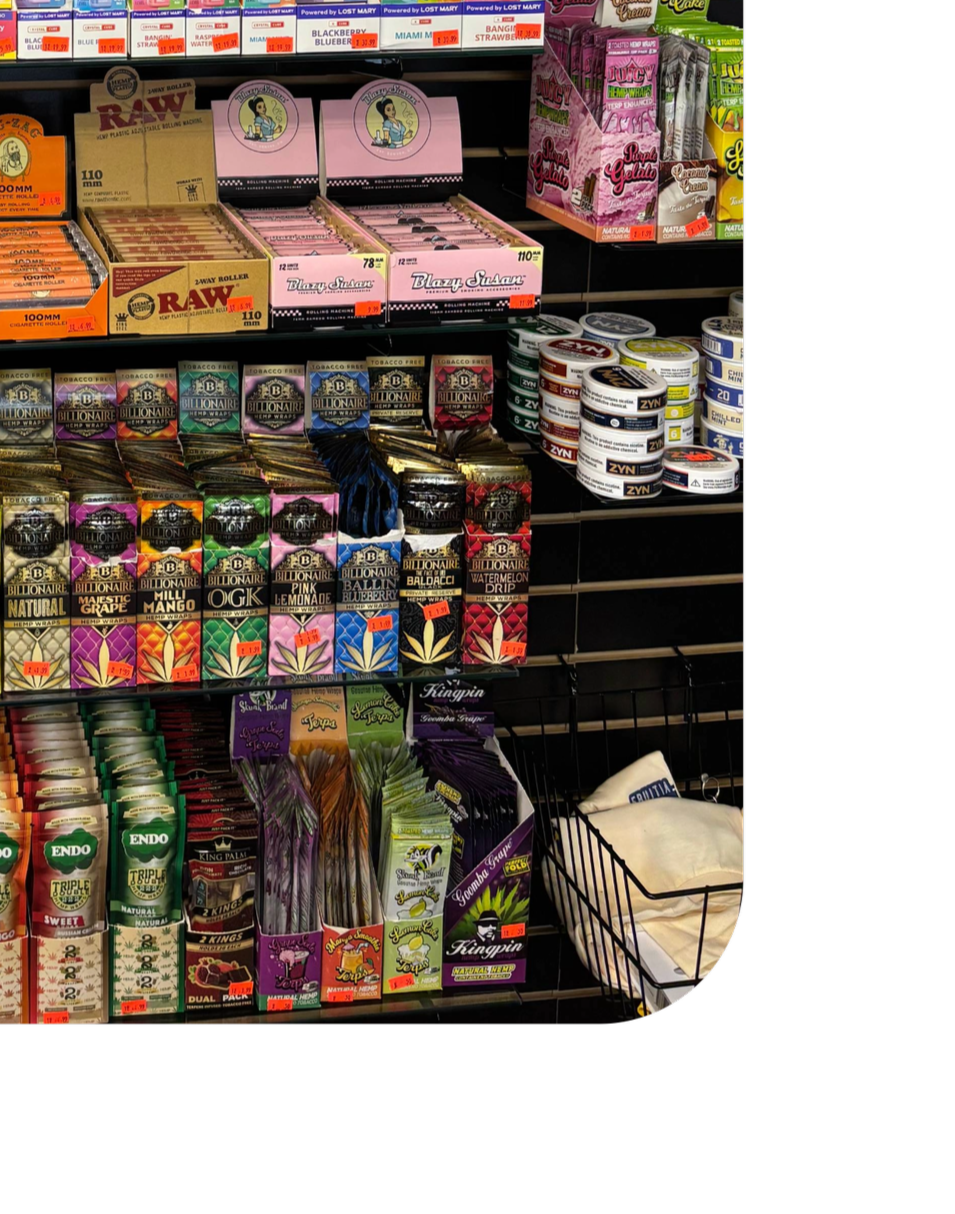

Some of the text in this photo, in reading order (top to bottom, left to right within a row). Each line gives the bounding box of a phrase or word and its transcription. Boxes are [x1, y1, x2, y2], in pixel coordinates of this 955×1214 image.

[325, 9, 337, 17] by
[618, 4, 653, 21] Cream
[97, 92, 188, 132] RAW
[623, 142, 657, 165] Purple
[82, 170, 103, 180] 110
[604, 160, 657, 197] Gelato
[518, 250, 532, 262] 110
[363, 258, 375, 269] 78
[195, 273, 249, 285] 2-WAY ROLLER
[411, 270, 524, 292] Blazy Susan
[711, 411, 741, 423] CHILLED
[711, 416, 727, 426] MINT
[609, 464, 636, 474] ZYN
[470, 572, 529, 583] WATERMELON
[485, 583, 516, 593] DRIP
[154, 589, 186, 601] MILLI
[274, 593, 332, 606] LEMONADE
[342, 590, 399, 603] BLUEBERRY
[8, 597, 66, 618] NATURAL
[143, 599, 195, 613] MANGO
[420, 684, 486, 705] Kingpin
[44, 915, 79, 926] SWEET
[447, 939, 524, 963] Kingpin
[188, 995, 216, 1004] DUAL
